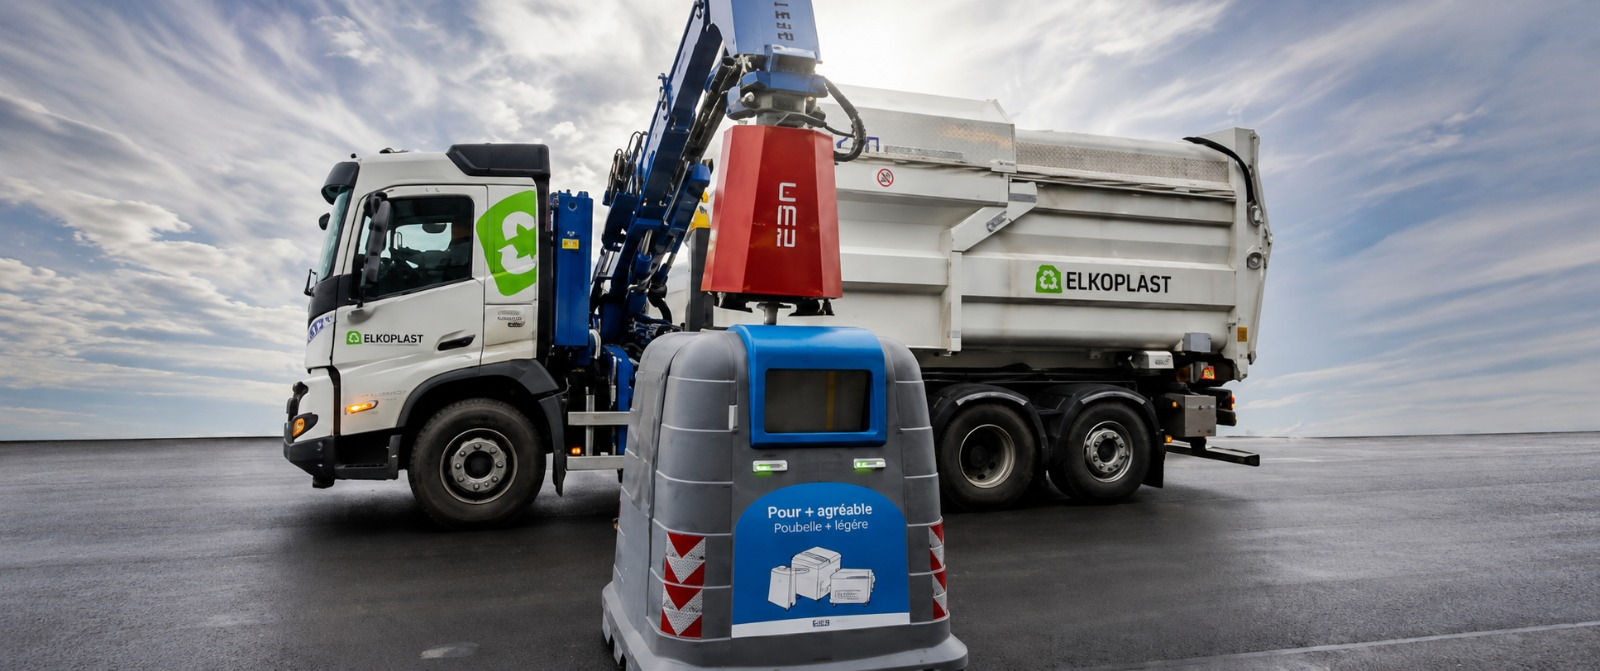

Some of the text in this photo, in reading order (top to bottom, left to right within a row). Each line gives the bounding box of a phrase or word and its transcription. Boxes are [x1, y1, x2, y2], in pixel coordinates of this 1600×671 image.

[1066, 271, 1172, 294] ELKOPLAST
[363, 333, 424, 344] ELKOPLAST
[768, 506, 802, 519] Pour
[817, 503, 872, 520] agréable
[774, 521, 822, 533] Poubelle
